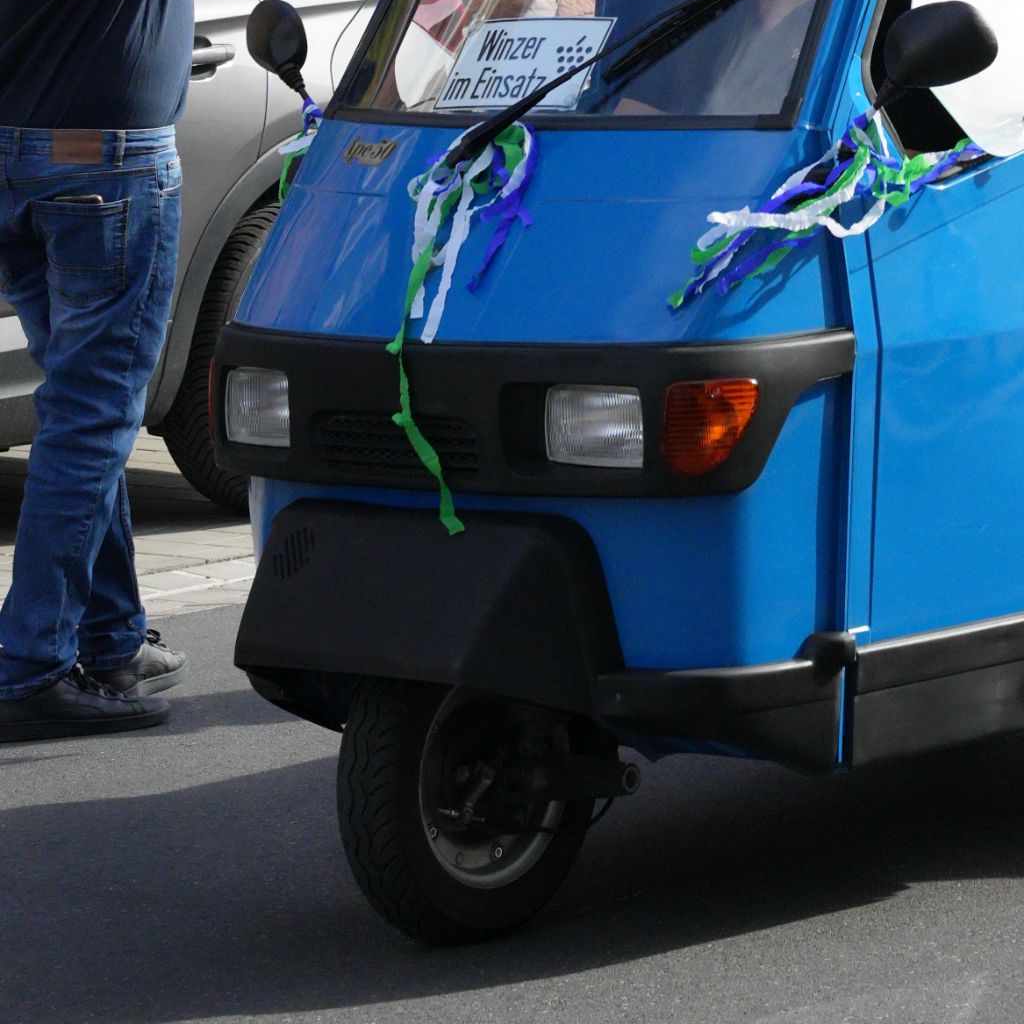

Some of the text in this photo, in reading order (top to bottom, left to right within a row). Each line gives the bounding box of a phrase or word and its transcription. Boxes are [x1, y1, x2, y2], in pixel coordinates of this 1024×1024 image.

[477, 29, 546, 62] Winzer
[443, 67, 547, 101] im Einsatz
